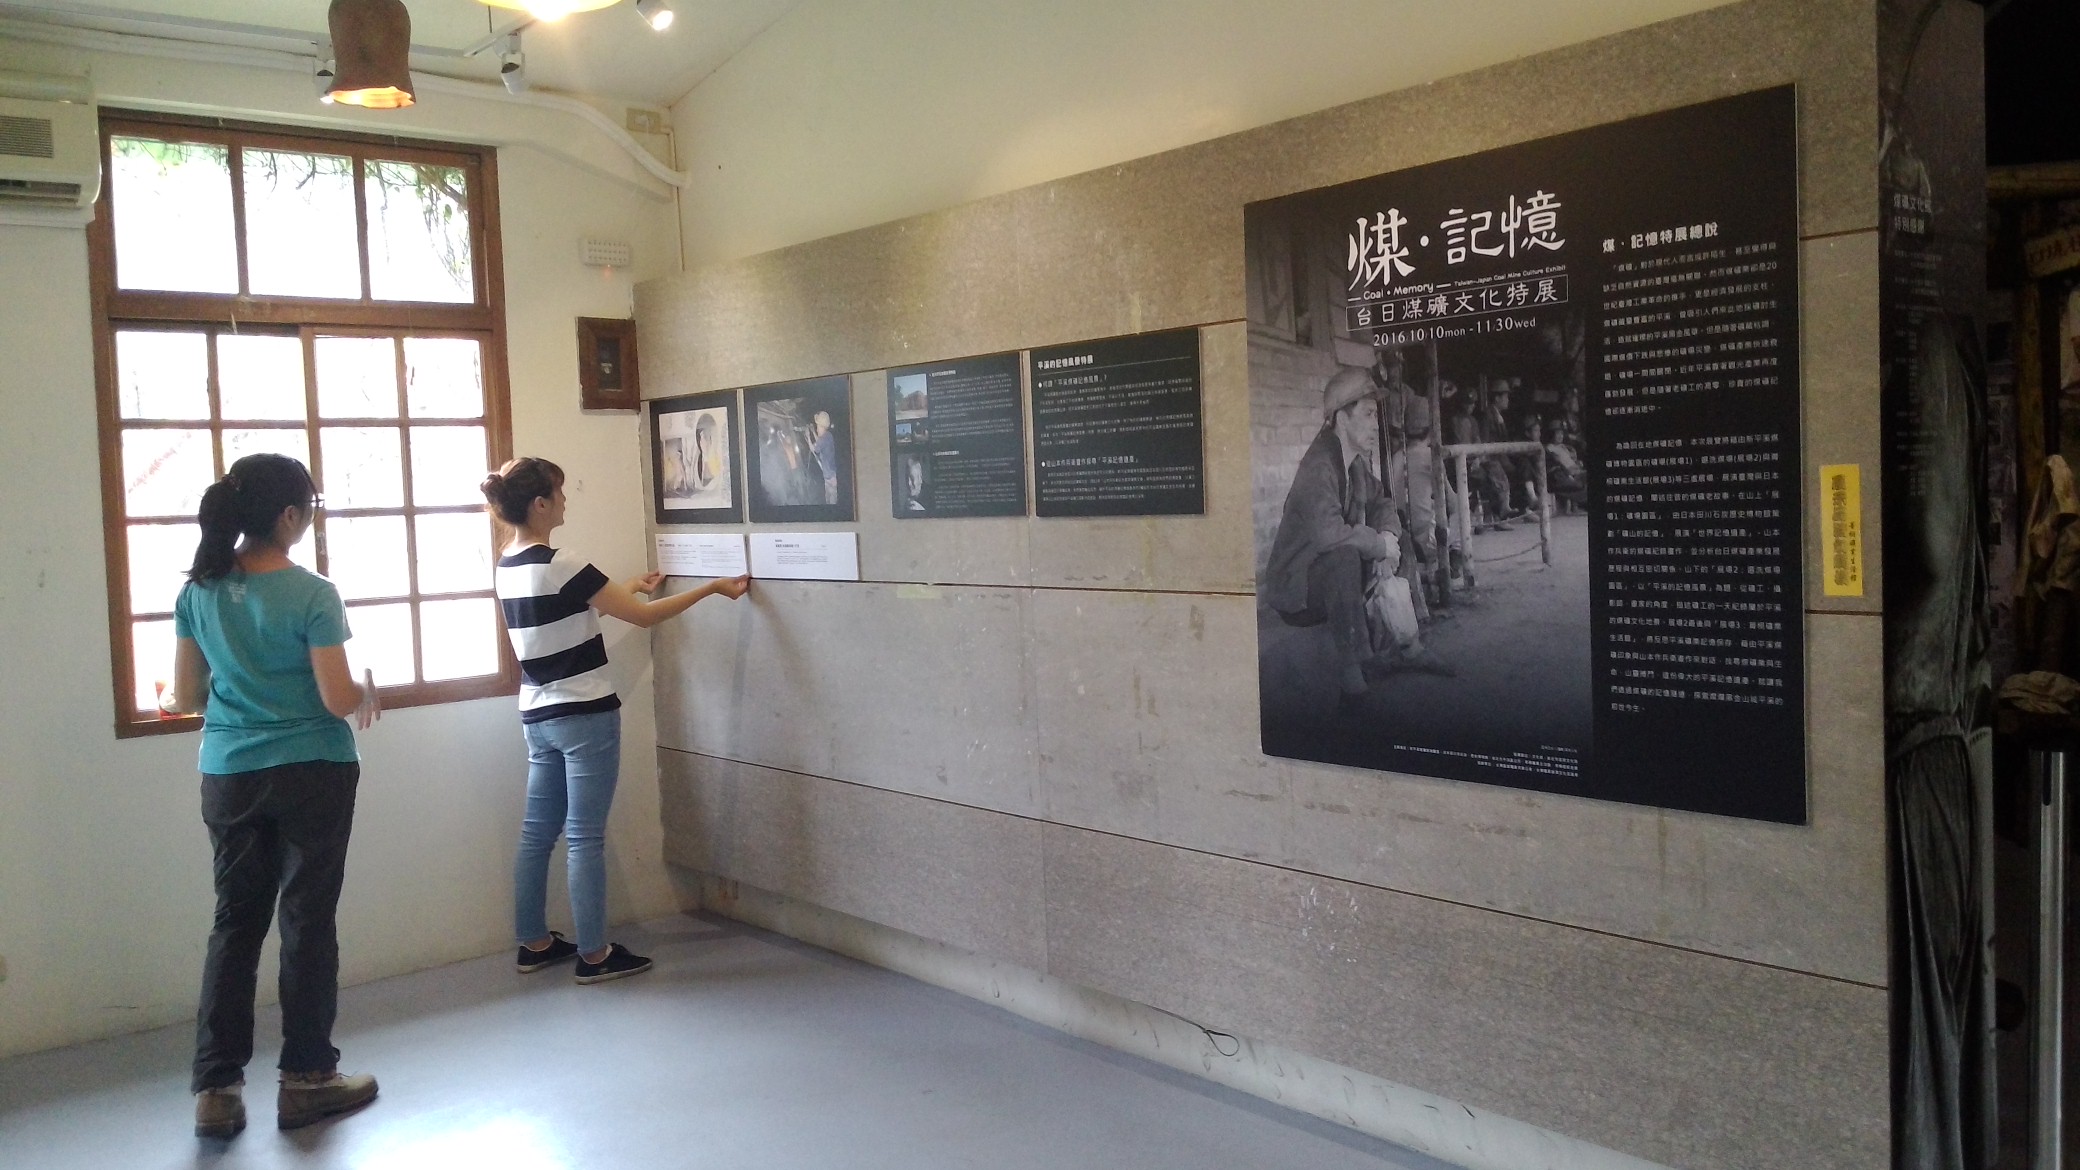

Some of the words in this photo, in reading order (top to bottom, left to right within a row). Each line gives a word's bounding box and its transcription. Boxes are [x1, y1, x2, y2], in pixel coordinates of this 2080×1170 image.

[1357, 279, 1558, 327] 台日煤礦文化特展
[1363, 290, 1384, 301] Coal
[1393, 282, 1434, 296] Memory
